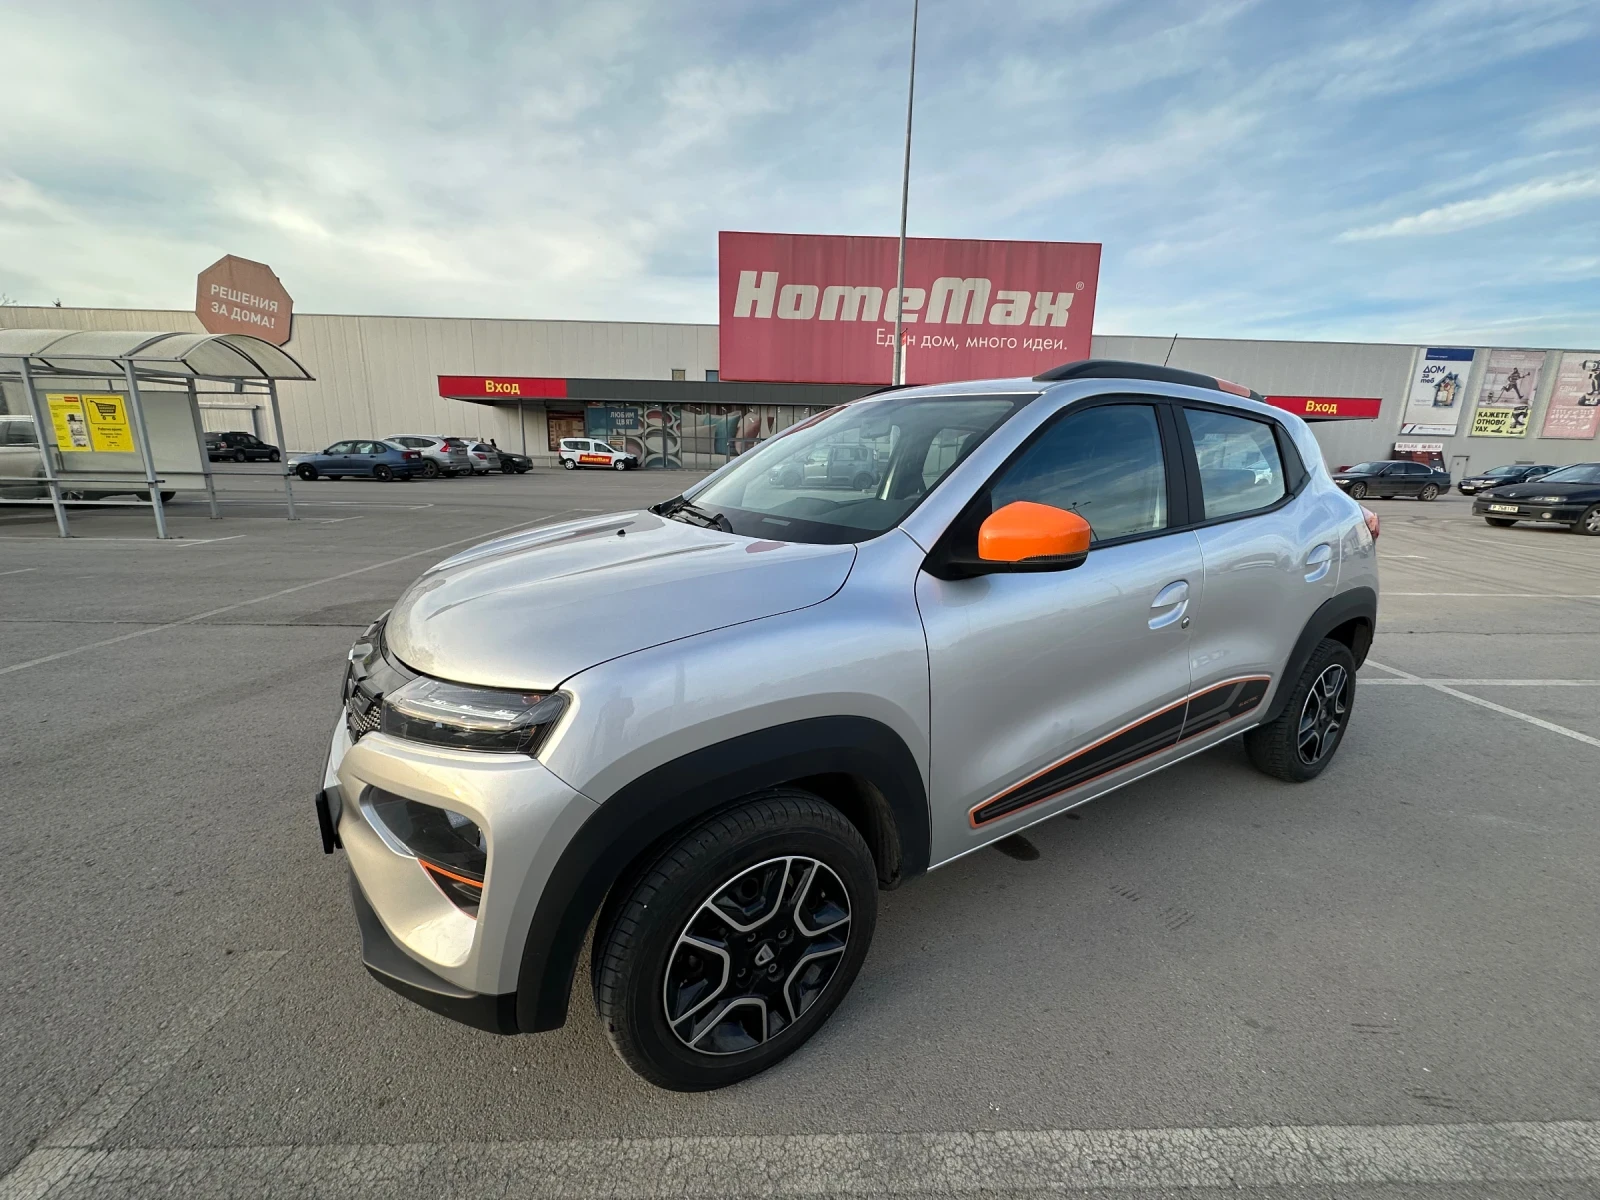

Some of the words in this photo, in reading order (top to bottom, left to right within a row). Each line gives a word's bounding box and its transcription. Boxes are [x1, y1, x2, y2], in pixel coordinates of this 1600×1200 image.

[211, 284, 278, 312] РЕШЕНИЯ
[733, 270, 1074, 327] HomeMax
[211, 302, 228, 316] ЗА
[231, 308, 275, 329] ДОМА!
[876, 328, 916, 347] Едн
[920, 335, 959, 350] дом,
[966, 337, 1017, 348] много
[1023, 337, 1067, 351] идеи.
[1423, 365, 1446, 374] ДОМ
[485, 379, 520, 395] Вход
[1305, 400, 1337, 415] Вход
[616, 418, 633, 426] ЦВЯТ
